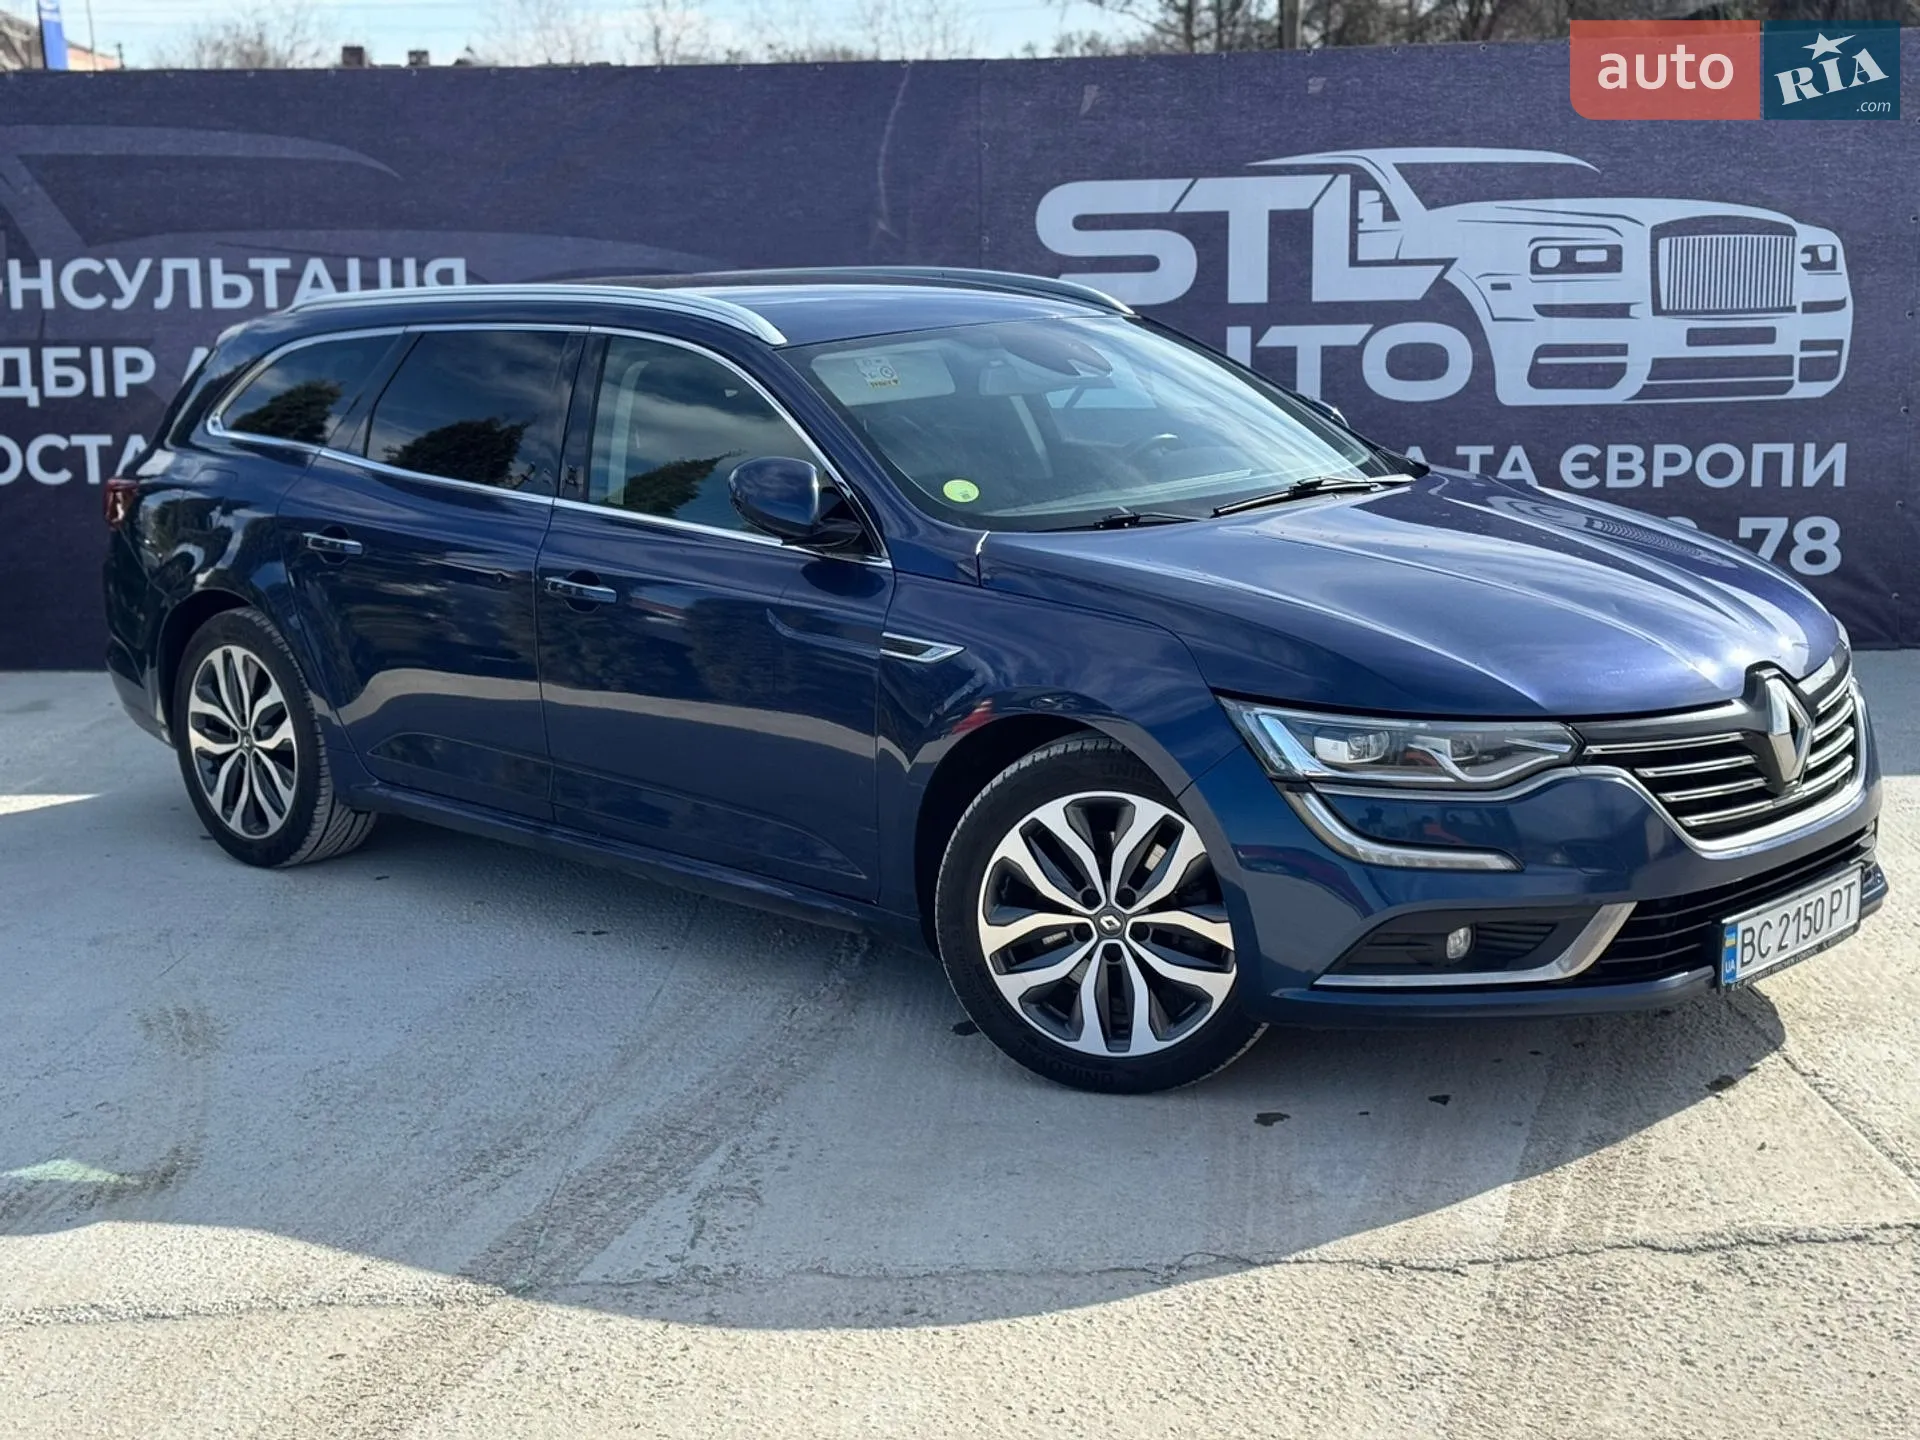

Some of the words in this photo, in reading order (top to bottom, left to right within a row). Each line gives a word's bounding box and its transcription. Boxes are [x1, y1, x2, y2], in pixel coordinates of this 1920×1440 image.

[1035, 173, 1446, 306] STL
[1455, 444, 1540, 487] ТА
[1558, 442, 1848, 489] ЄВРОПИ
[1740, 919, 1773, 968] BC
[1777, 896, 1826, 953] 2150
[1828, 881, 1856, 929] PT
